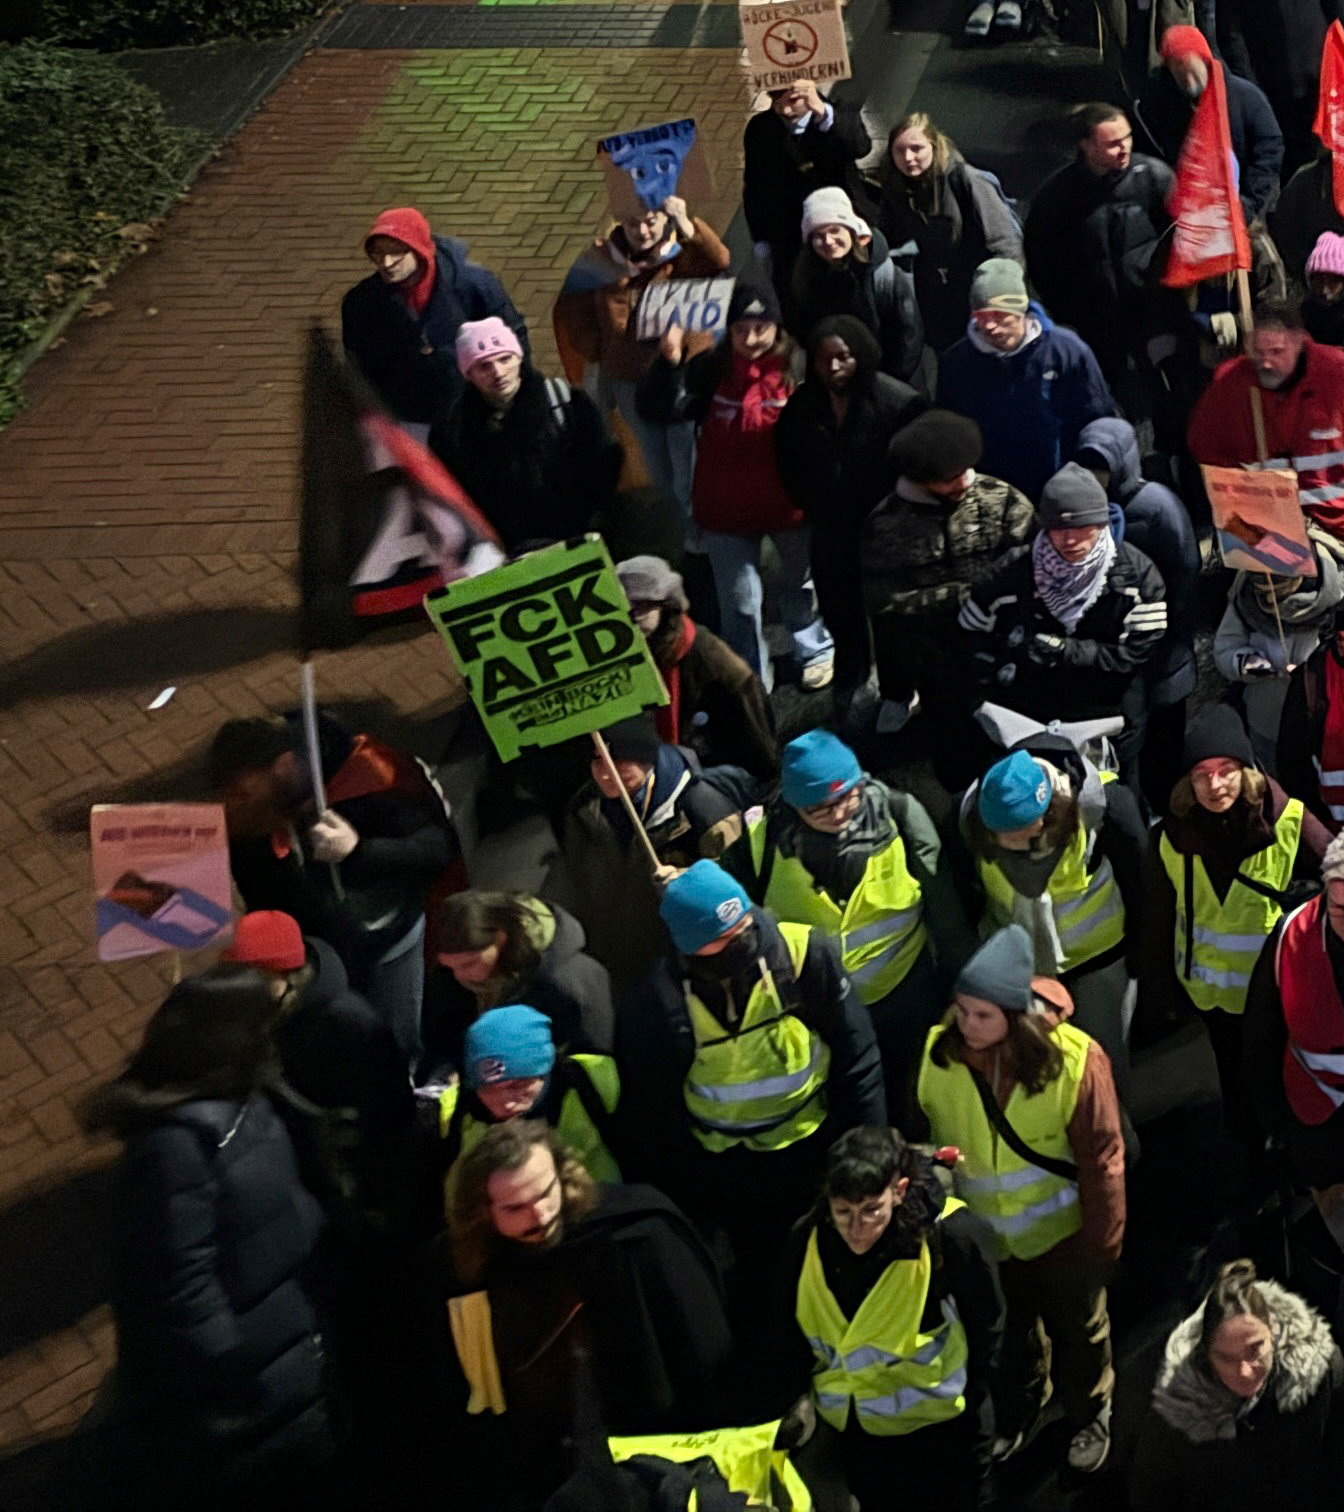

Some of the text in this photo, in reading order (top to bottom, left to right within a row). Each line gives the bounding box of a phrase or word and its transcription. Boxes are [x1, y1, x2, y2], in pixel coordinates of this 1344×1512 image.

[753, 60, 845, 88] VERHINDERN!
[448, 573, 620, 664] FCK
[482, 619, 635, 704] AFD
